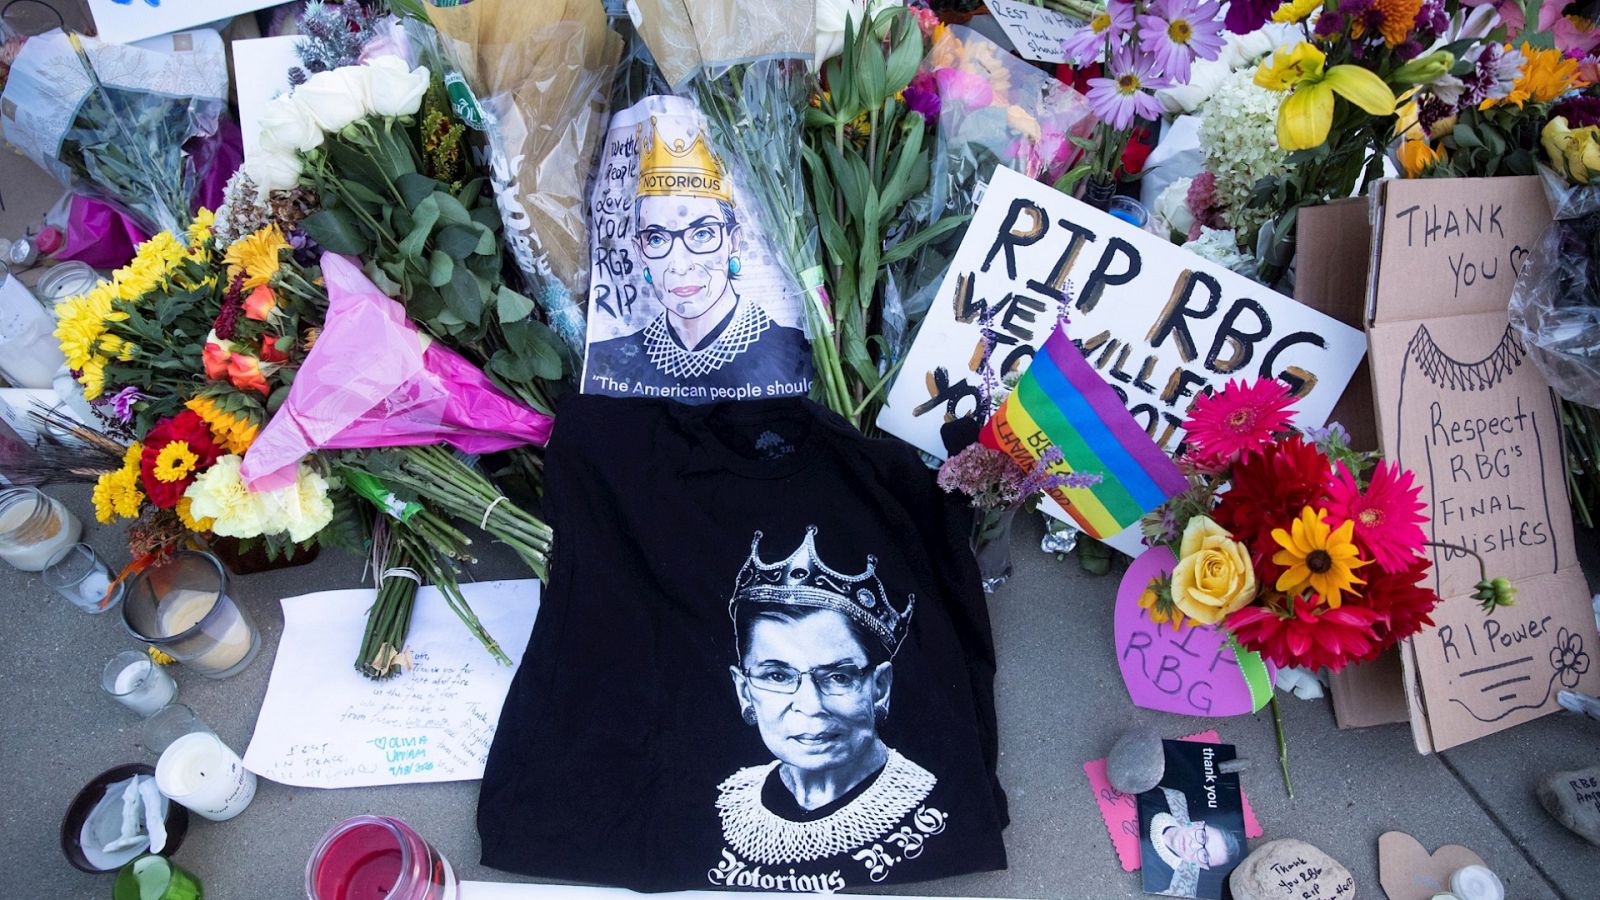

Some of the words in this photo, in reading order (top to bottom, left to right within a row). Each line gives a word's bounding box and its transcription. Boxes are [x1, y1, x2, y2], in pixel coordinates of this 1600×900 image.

[605, 160, 636, 187] People
[643, 175, 721, 191] NOTORIOUS
[595, 188, 633, 214] Love
[1396, 204, 1504, 247] THANK
[594, 247, 634, 282] RGB
[1449, 252, 1498, 298] YOU
[594, 284, 637, 319] RIP
[953, 271, 1048, 341] WE
[981, 198, 1142, 315] RIP
[1144, 268, 1330, 398] RBG
[632, 381, 707, 397] American
[710, 383, 762, 400] people
[1430, 397, 1528, 452] Respect
[1450, 445, 1523, 483] RBG's
[1440, 494, 1526, 526] FINAL
[1123, 630, 1213, 715] RBG
[1203, 747, 1217, 782] thank
[1203, 785, 1218, 808] you
[707, 847, 846, 895] Notorious
[1270, 857, 1307, 876] Thank
[1302, 883, 1320, 900] RIP
